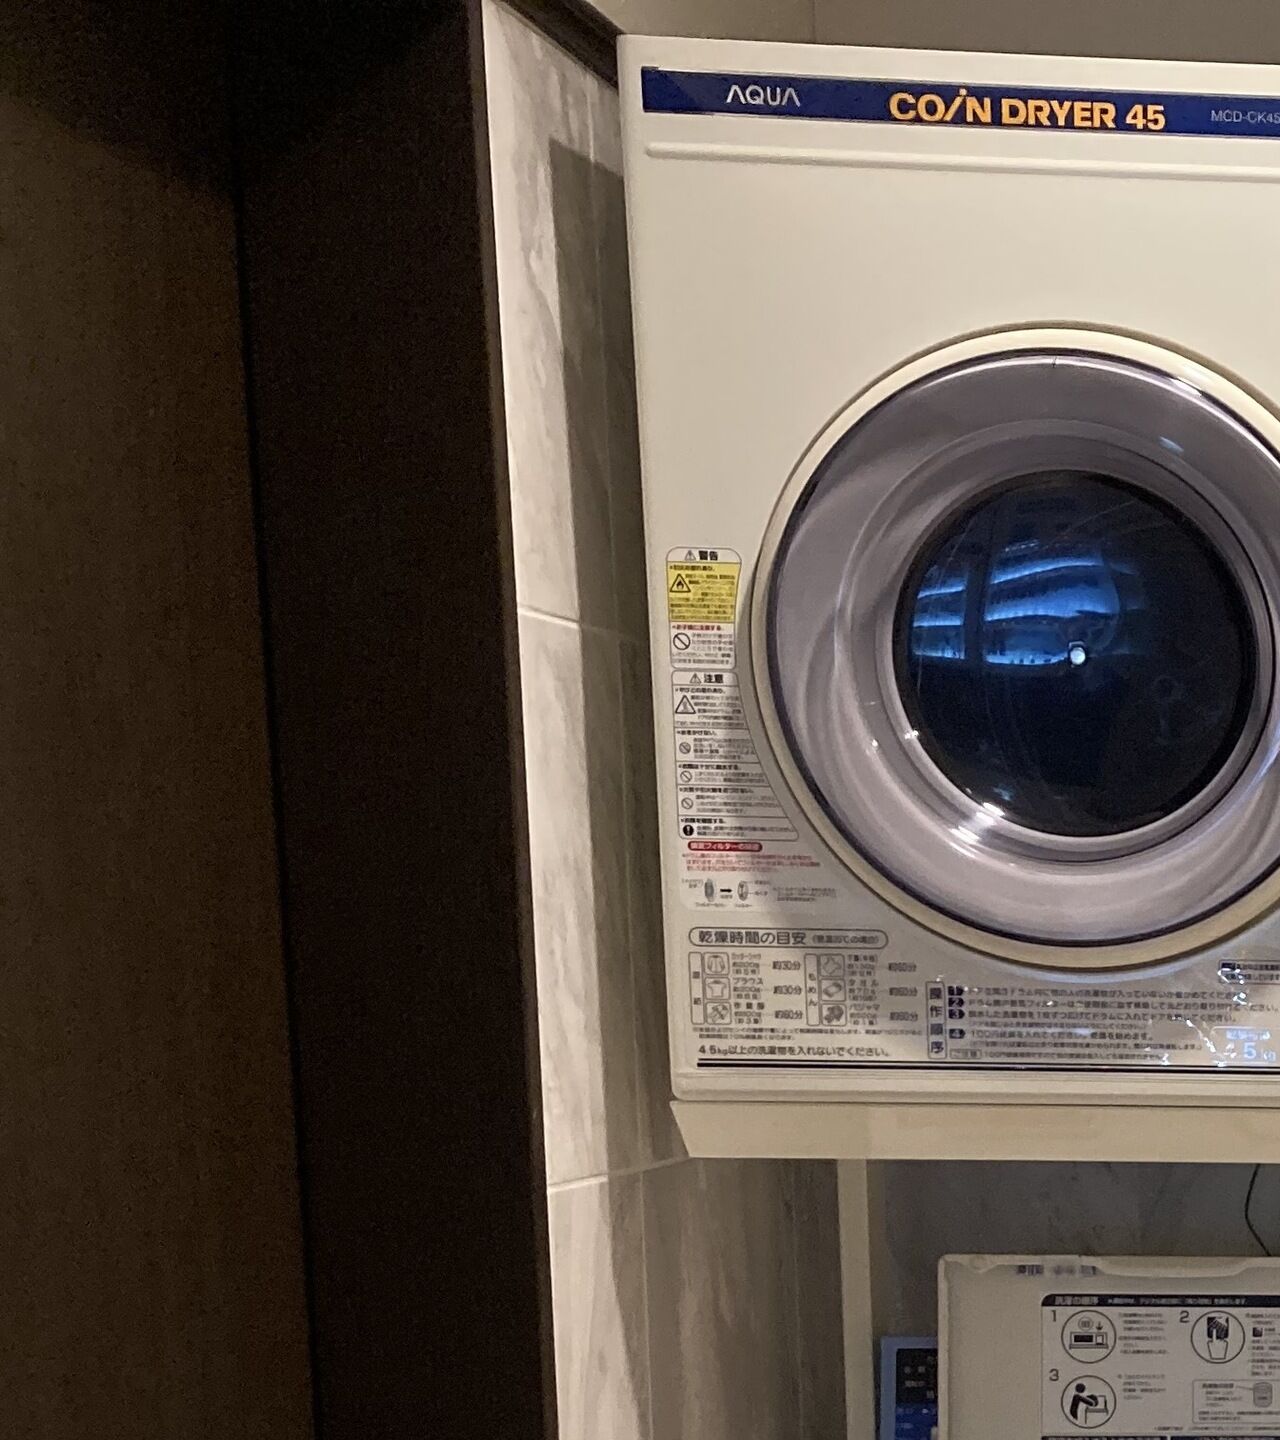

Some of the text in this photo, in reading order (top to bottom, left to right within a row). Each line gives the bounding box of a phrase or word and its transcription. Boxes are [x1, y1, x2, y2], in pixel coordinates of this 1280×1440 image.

[725, 84, 800, 108] AQUA
[1001, 98, 1115, 126] DRYER
[1126, 103, 1165, 128] 45
[1210, 107, 1280, 124] MCD-CK45
[699, 551, 718, 560] 警告
[704, 674, 723, 683] 注意
[699, 931, 806, 944] 乾燥時間の目安
[929, 987, 943, 1054] 操作順序
[1051, 1310, 1056, 1322] 1
[1180, 1311, 1189, 1323] 2
[1049, 1369, 1059, 1381] 3
